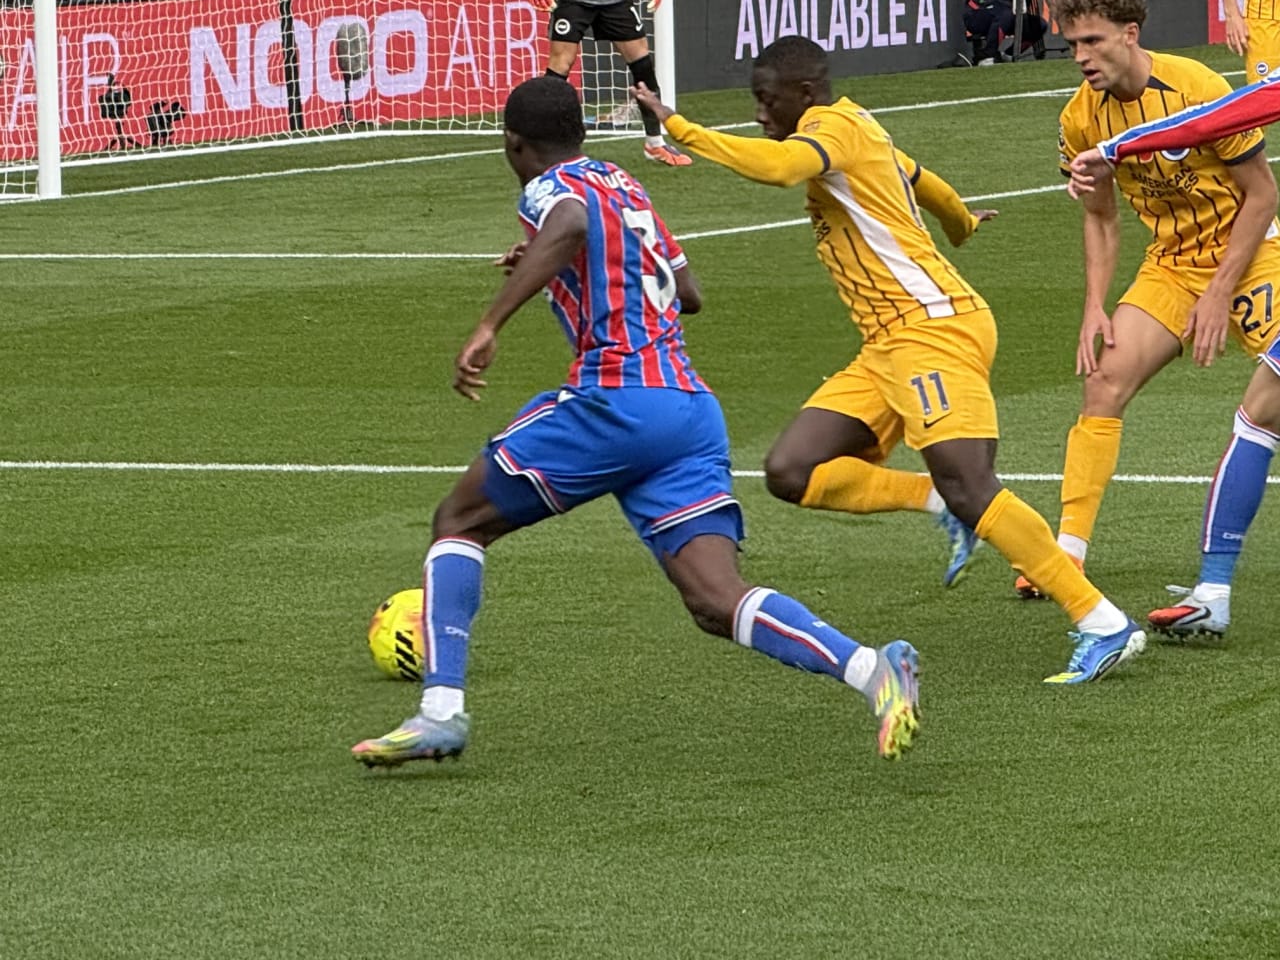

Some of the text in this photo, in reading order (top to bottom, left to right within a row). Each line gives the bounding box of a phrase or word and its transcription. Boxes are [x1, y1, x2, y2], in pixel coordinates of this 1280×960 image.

[444, 1, 537, 91] AIR
[1233, 282, 1274, 333] 27
[910, 371, 949, 415] 11
